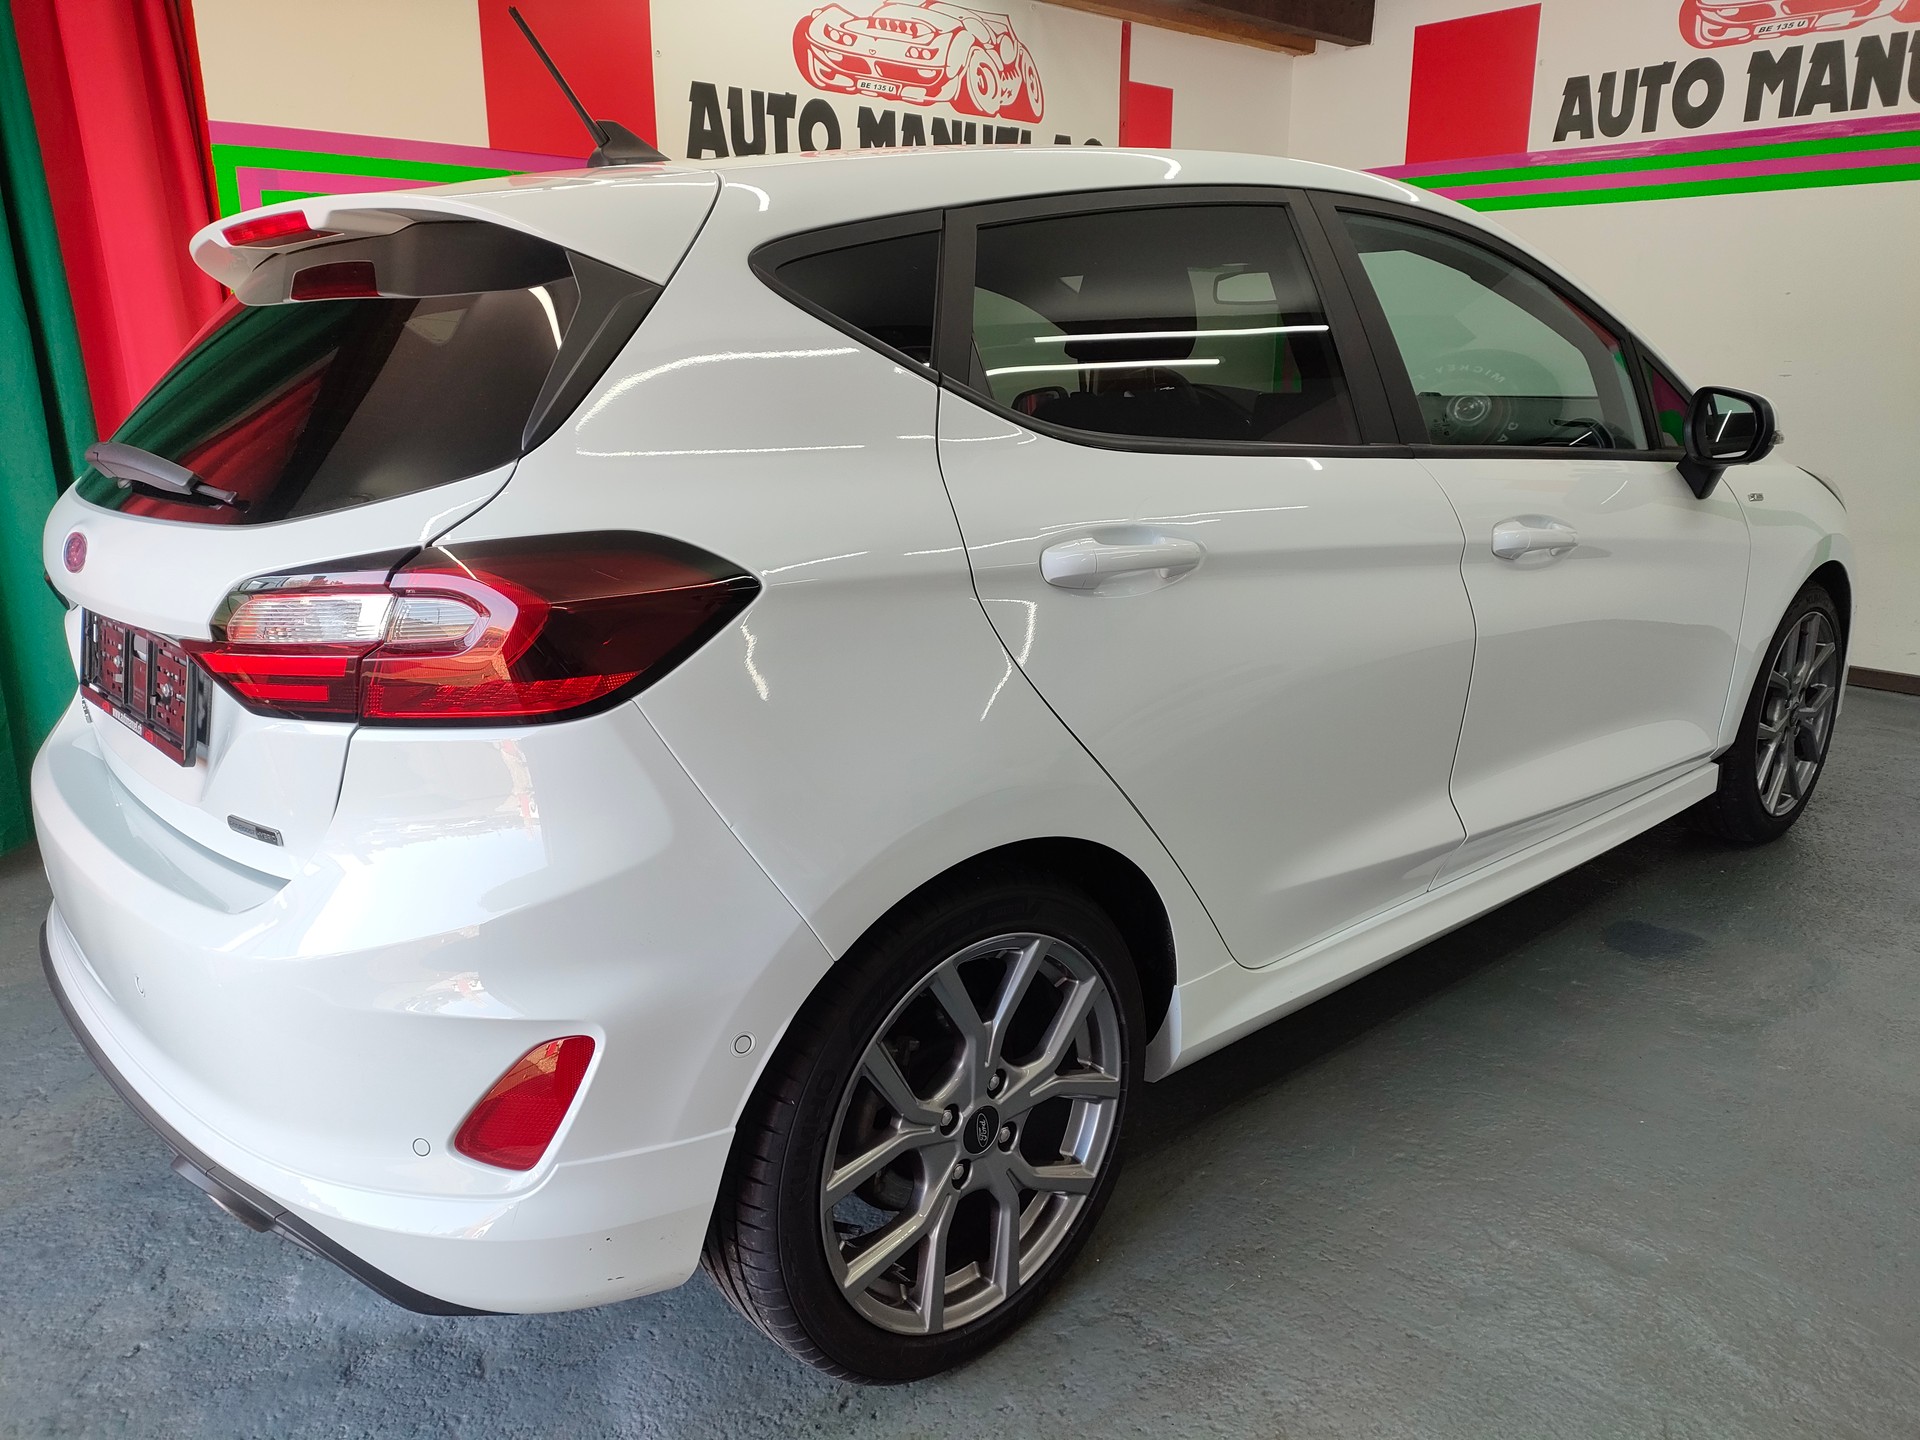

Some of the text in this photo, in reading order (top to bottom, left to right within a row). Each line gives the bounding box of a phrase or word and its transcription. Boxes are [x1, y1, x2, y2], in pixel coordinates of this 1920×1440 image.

[1758, 20, 1806, 33] BE 135 U
[860, 81, 872, 89] BE
[873, 83, 887, 92] 135
[1552, 57, 1725, 142] AUTO
[686, 80, 842, 160] AUTO
[979, 1120, 988, 1142] Ford
